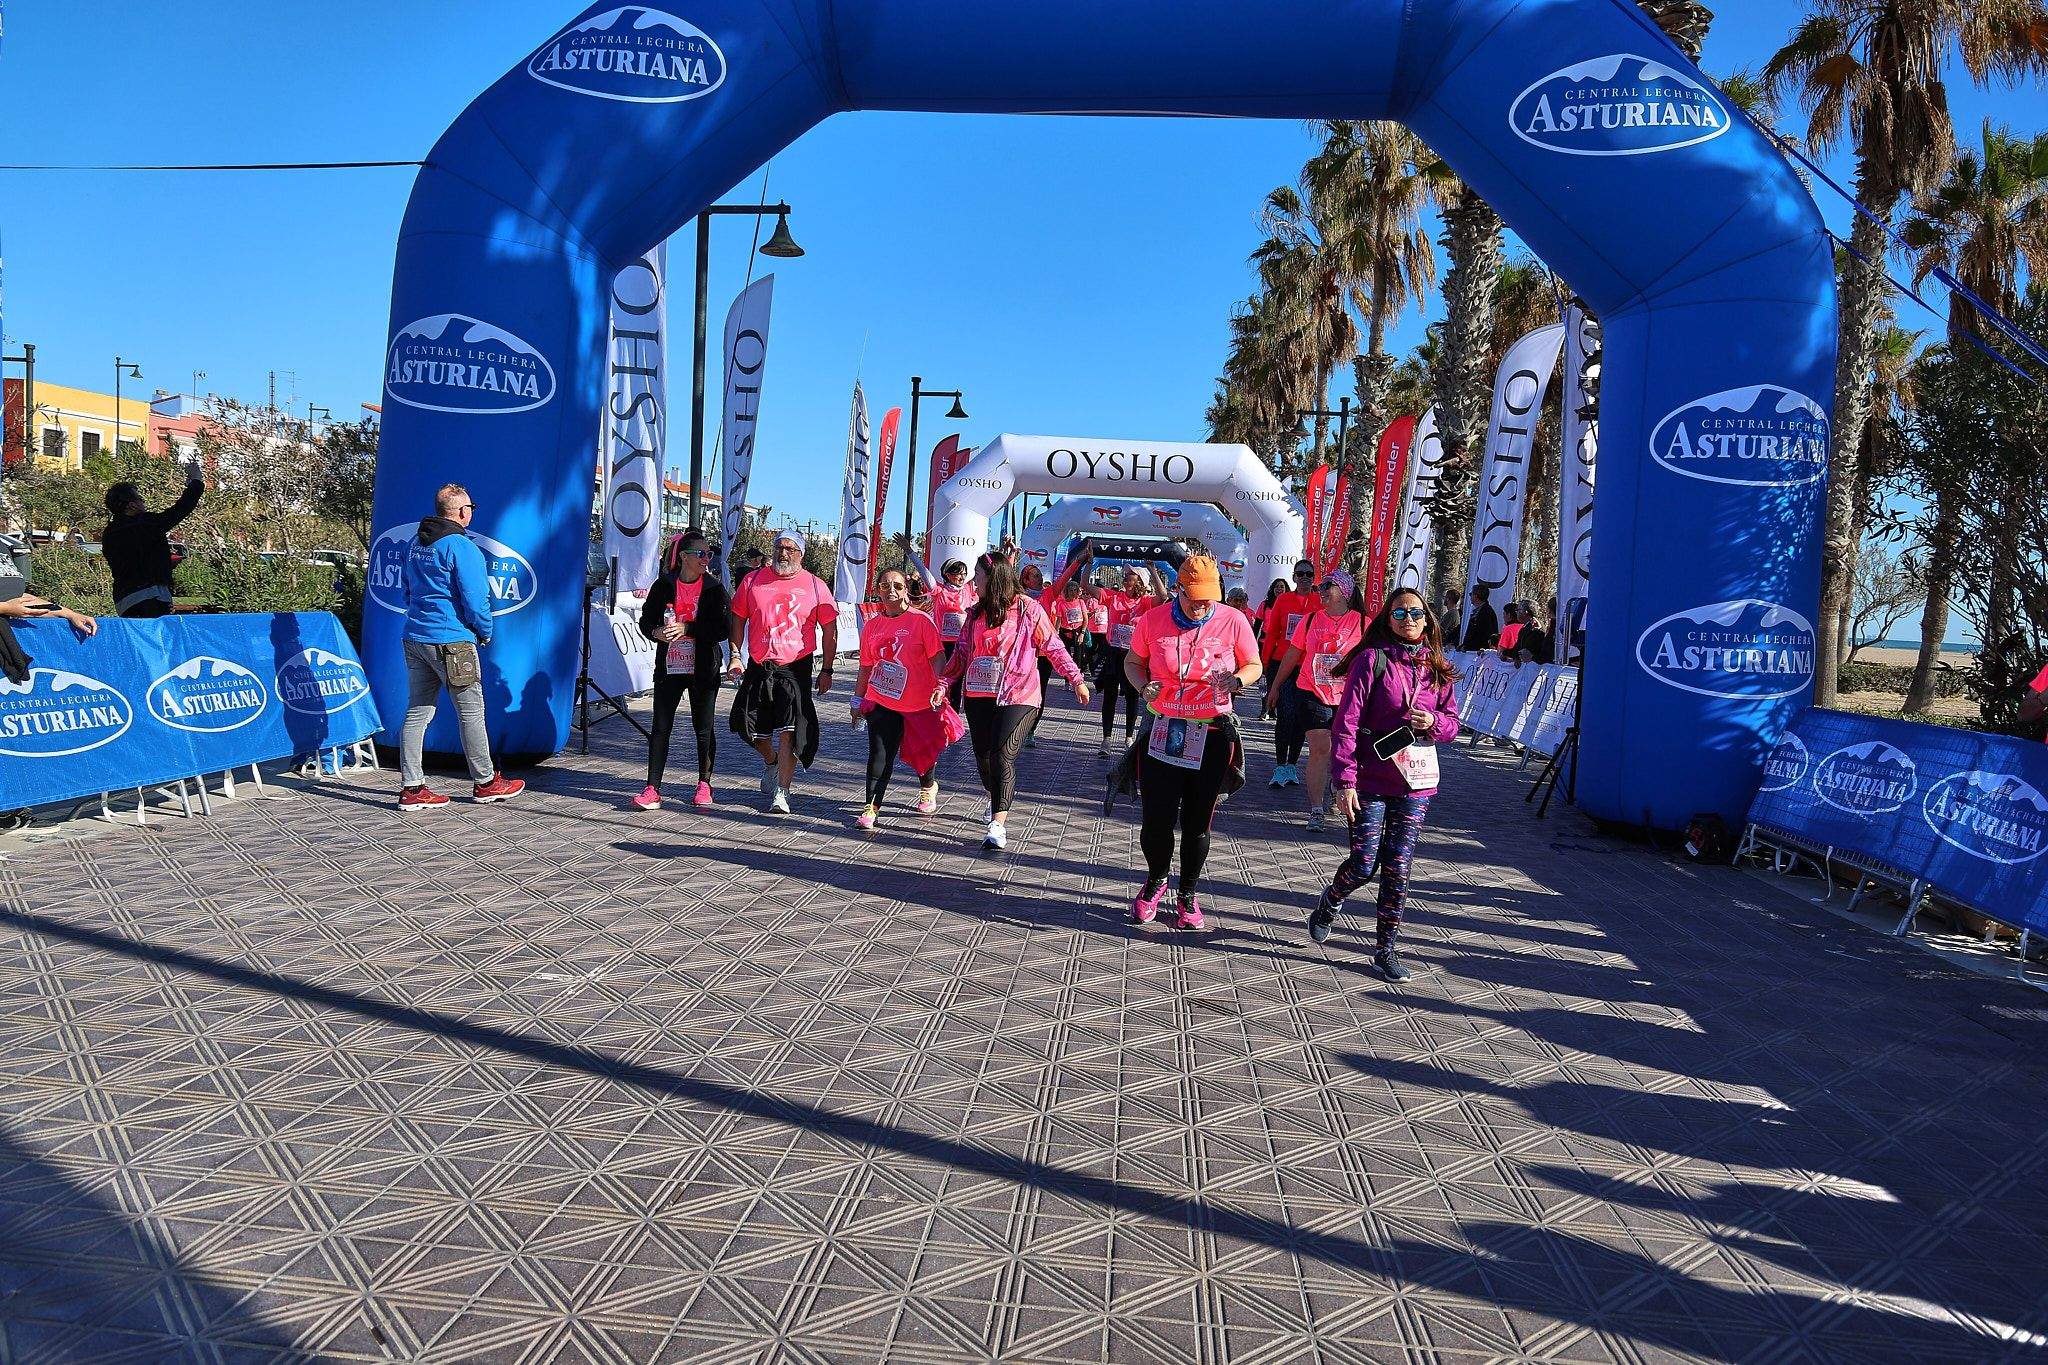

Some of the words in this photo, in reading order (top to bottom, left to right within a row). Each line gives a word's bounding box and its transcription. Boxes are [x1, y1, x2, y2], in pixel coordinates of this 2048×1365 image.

[571, 35, 630, 47] CENTRAL
[637, 36, 704, 54] LECHERA
[536, 43, 710, 86] ASTURIANA
[1565, 87, 1639, 100] CENTRAL
[1645, 87, 1708, 103] LECHERA
[1525, 93, 1721, 133] ASTURIANA
[388, 348, 541, 399] ASTURIANA
[405, 344, 462, 358] CENTRAL
[468, 350, 537, 370] LECHERA
[611, 257, 660, 538] OYSHO
[725, 328, 765, 541] OYSHO
[1664, 421, 1826, 464] ASTURIANA
[1701, 418, 1774, 429] CENTRAL
[1780, 421, 1826, 435] LECHERA
[878, 429, 893, 512] Santander
[1047, 449, 1194, 484] OYSHO
[1477, 369, 1539, 590] OYSHO
[958, 477, 1002, 490] OYSHO
[1235, 490, 1281, 503] OYSHO
[935, 534, 976, 548] OYSHO
[1371, 561, 1382, 613] Sports
[1378, 442, 1401, 533] Santander
[1099, 543, 1162, 554] VOLVO
[1256, 553, 1298, 565] OYSHO
[612, 621, 654, 656] OYS
[1650, 632, 1812, 675] ASTURIANA
[1687, 631, 1759, 644] CENTRAL
[1765, 634, 1811, 646] LECHERA
[180, 682, 216, 693] CENTRAL
[218, 678, 253, 689] LECHERA
[284, 675, 366, 701] ASTURIANA
[1462, 664, 1510, 702] OYSHO
[0, 698, 57, 710] CENTRAL
[60, 693, 112, 705] LECHERA
[162, 688, 262, 719] ASTURIANA
[1409, 759, 1427, 769] 016
[1819, 760, 1908, 803] ASTURIANA
[1928, 785, 2042, 852] ASTURIANA
